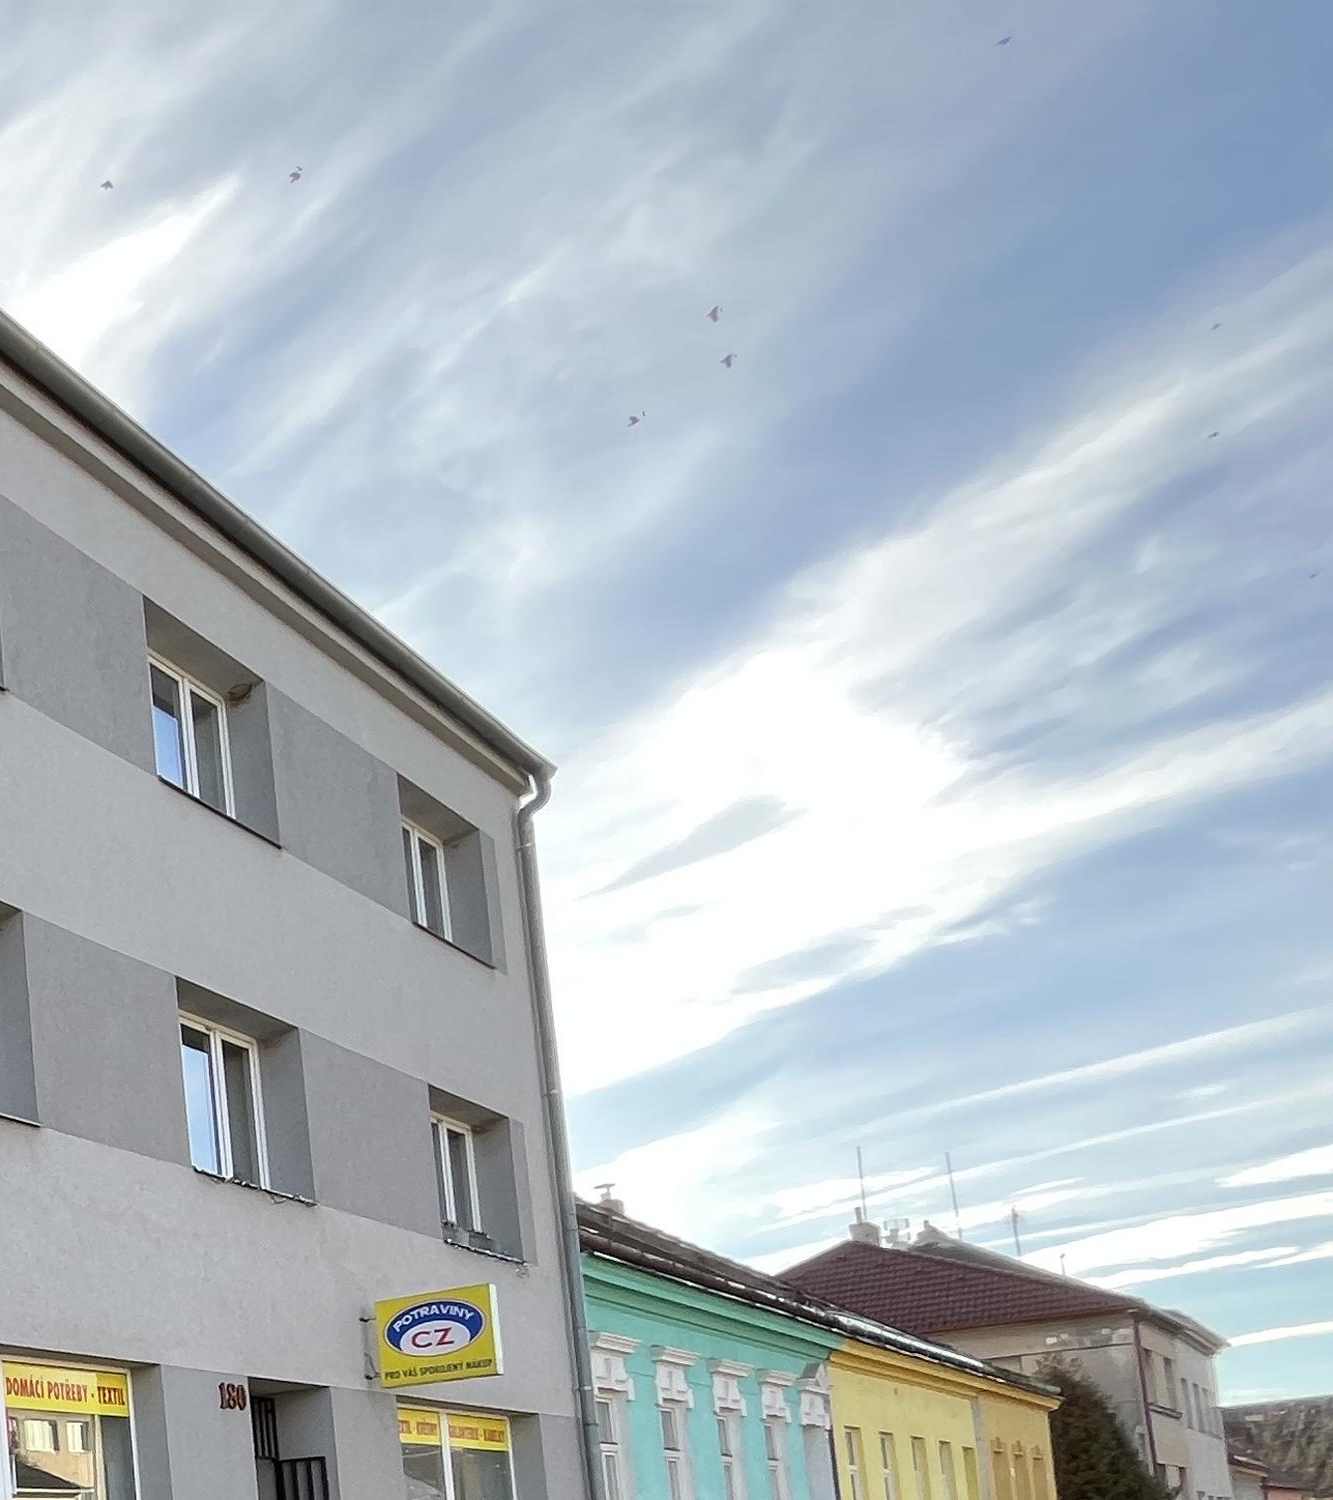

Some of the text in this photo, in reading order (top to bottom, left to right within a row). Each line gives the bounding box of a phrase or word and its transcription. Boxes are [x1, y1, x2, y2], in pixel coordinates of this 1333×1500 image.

[393, 1304, 475, 1332] POTRAVINY
[411, 1327, 455, 1348] CZ
[5, 1374, 126, 1406] DOMÁCÍ POTŘEBY TEXTIL
[218, 1381, 247, 1411] 180
